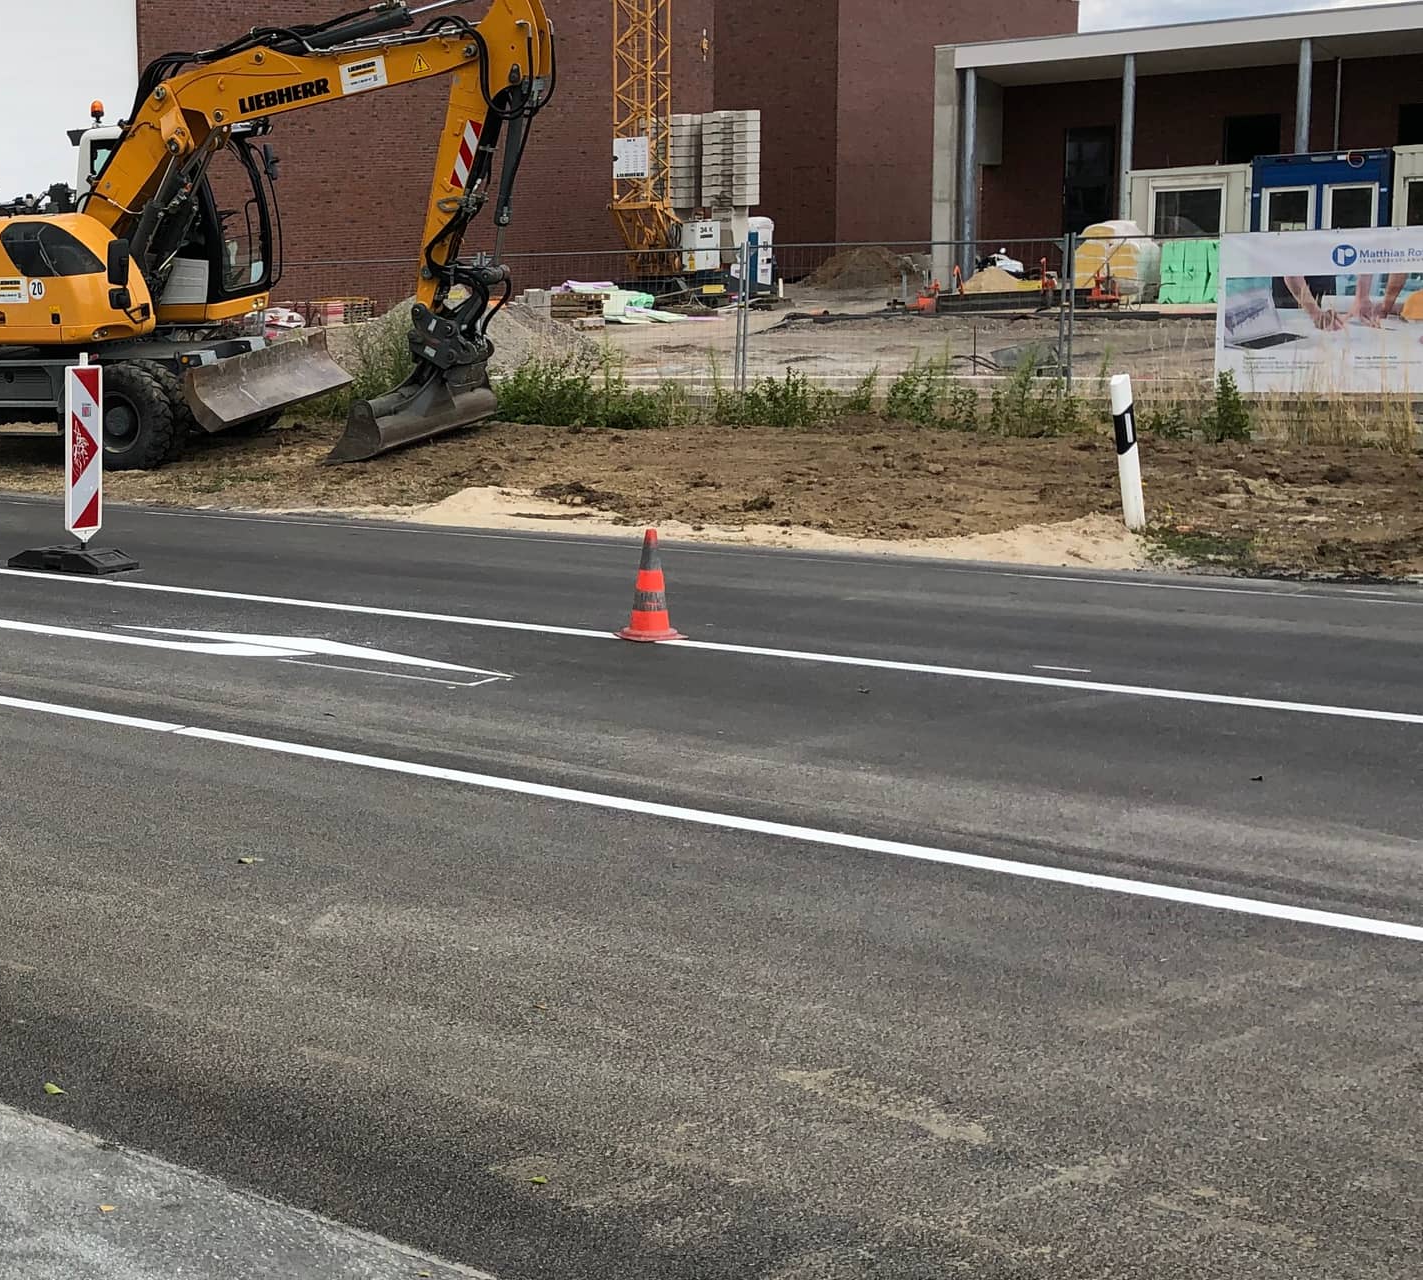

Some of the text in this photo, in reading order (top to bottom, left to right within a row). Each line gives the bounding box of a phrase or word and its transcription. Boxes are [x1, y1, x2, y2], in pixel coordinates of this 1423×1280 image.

[238, 77, 330, 114] LIEBHERR
[1359, 247, 1423, 258] Matthias Ro
[32, 282, 43, 296] 20
